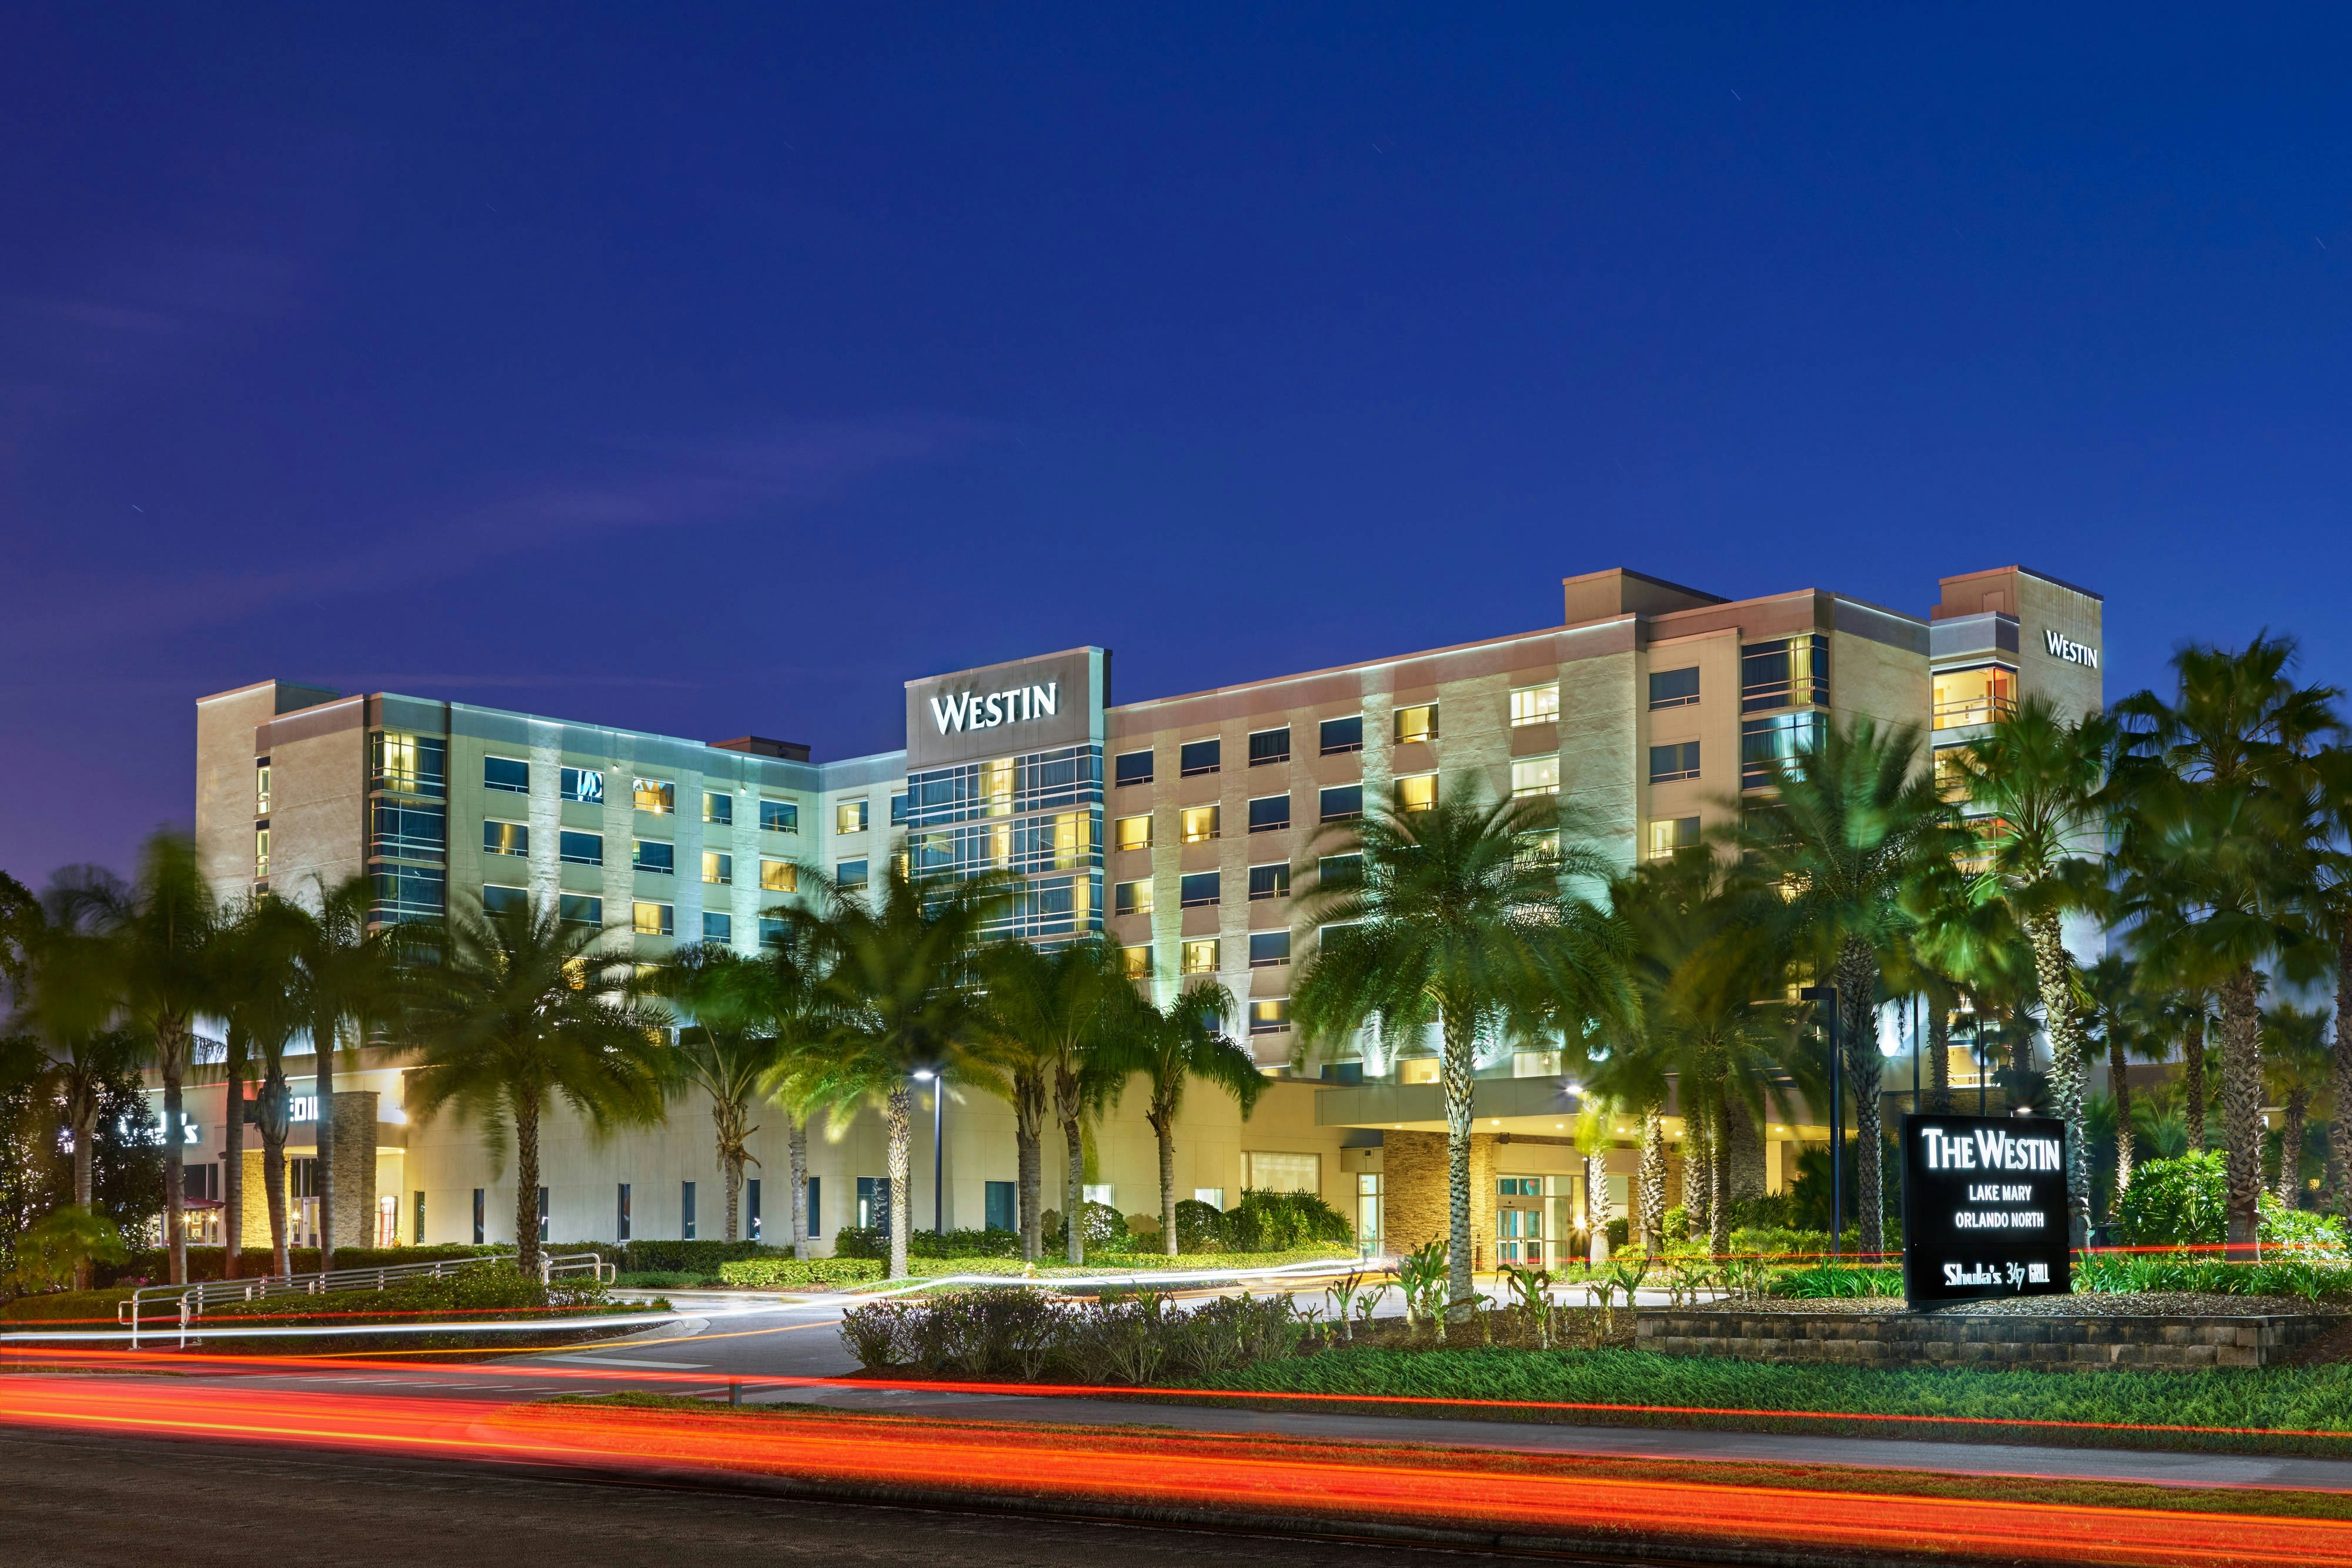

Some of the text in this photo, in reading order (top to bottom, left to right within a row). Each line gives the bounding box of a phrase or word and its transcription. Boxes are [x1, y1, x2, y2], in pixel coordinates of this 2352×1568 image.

[2046, 630, 2097, 668] WESTIN
[930, 682, 1056, 735] WESTIN
[1922, 1128, 2060, 1171] THE WESTIN
[1969, 1185, 2032, 1201] LAKE MARY
[1955, 1212, 2044, 1228] ORLANDO NORTH
[1944, 1263, 2002, 1286] Shula's
[2028, 1263, 2050, 1283] GRILL
